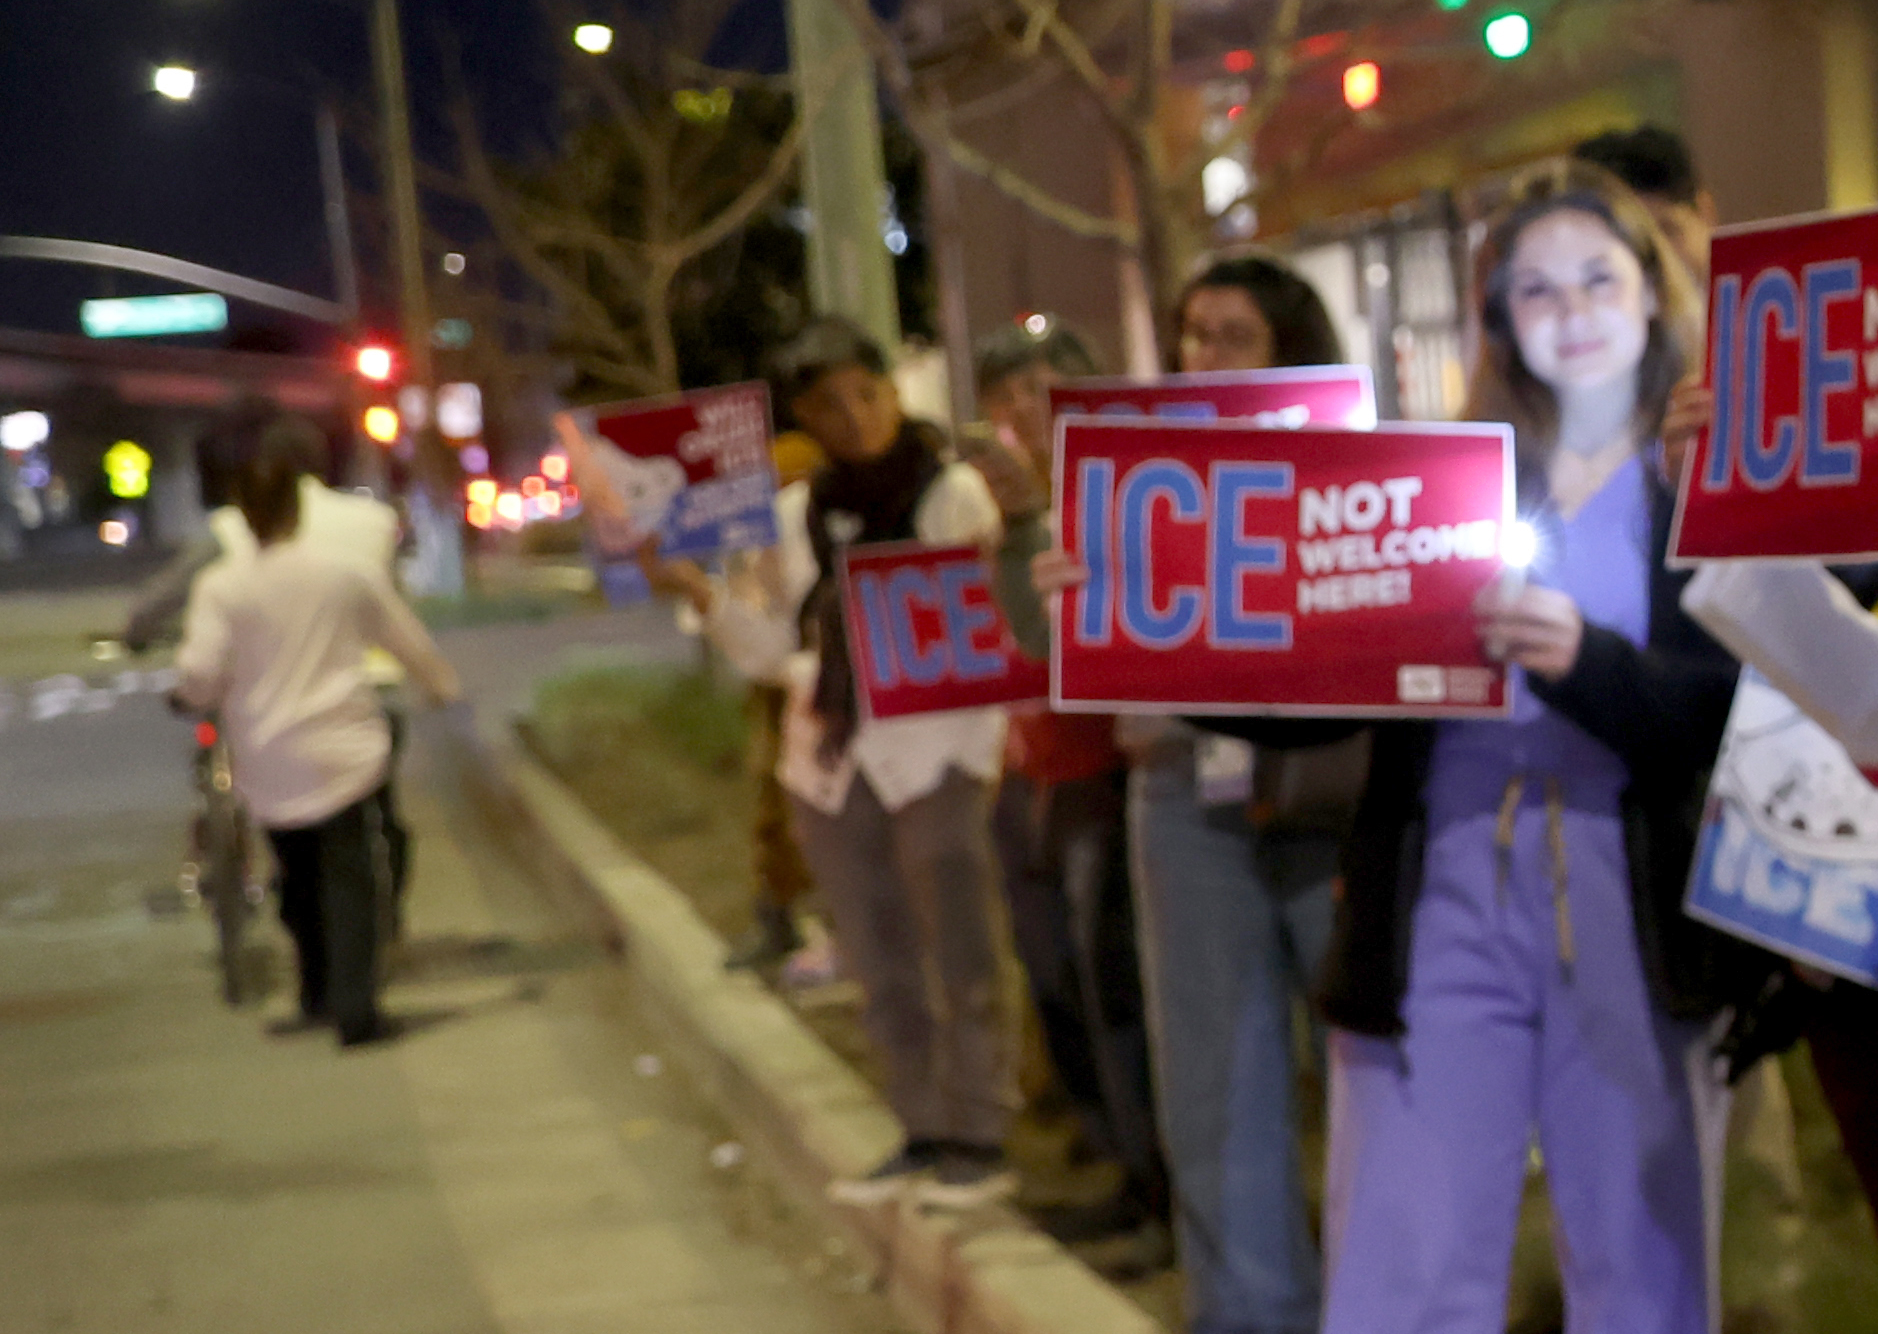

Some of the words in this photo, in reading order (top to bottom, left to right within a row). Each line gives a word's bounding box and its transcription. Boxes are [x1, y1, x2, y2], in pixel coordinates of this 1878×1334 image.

[1701, 257, 1862, 494] ICE
[1299, 520, 1497, 575] WELCOME
[1300, 476, 1422, 536] NOT
[1075, 457, 1296, 651] ICE
[1299, 569, 1412, 615] HERE!
[857, 561, 1009, 688] ICE
